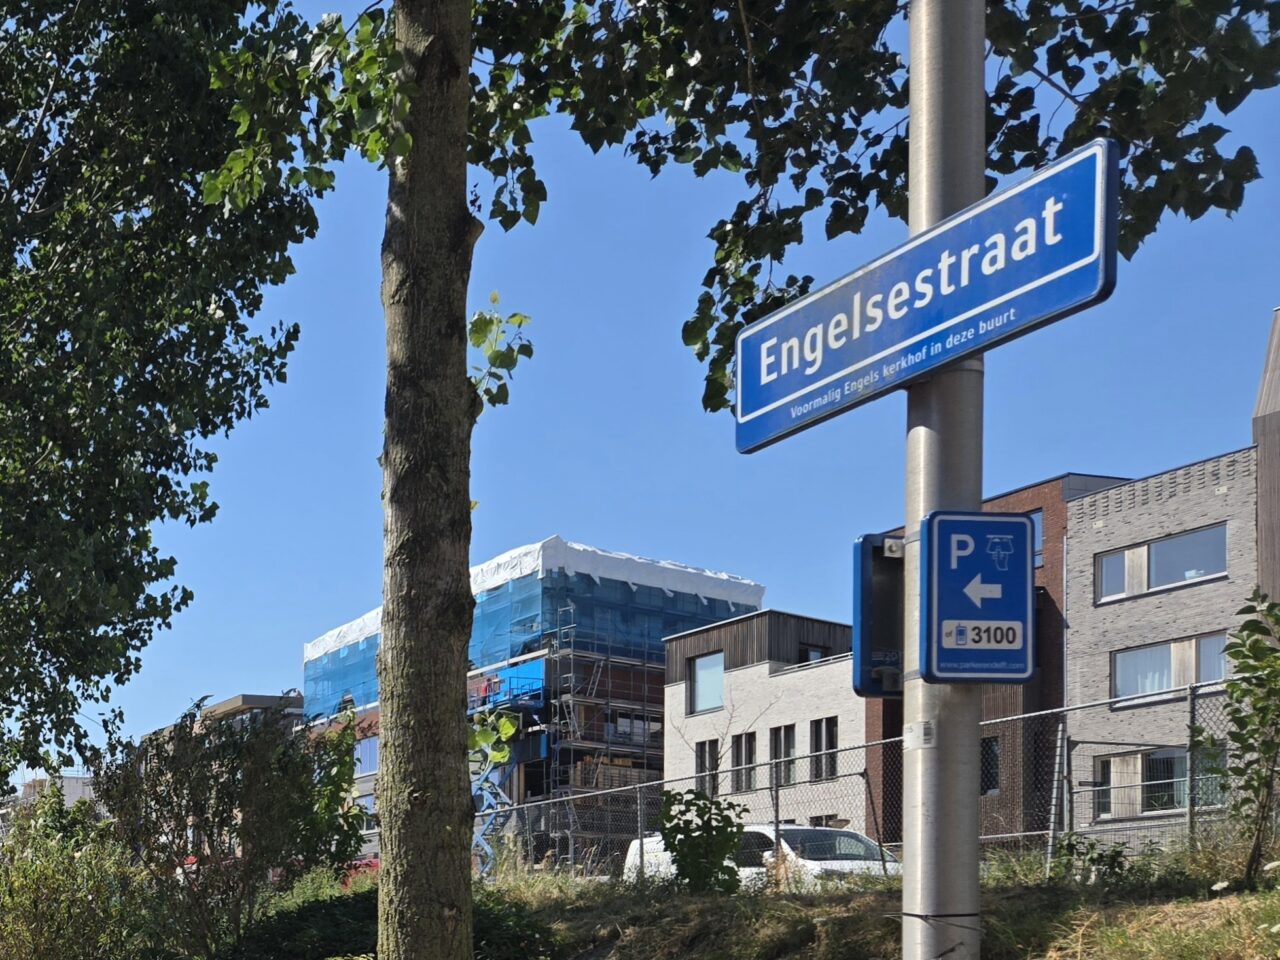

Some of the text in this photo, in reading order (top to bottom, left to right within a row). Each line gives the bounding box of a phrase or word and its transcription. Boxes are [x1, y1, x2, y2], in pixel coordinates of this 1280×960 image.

[759, 197, 1064, 386] Engelsestraat
[790, 307, 1016, 418] Voormalig Engels kerkhof in deze buurt
[951, 534, 975, 570] P
[971, 626, 1017, 645] 3100
